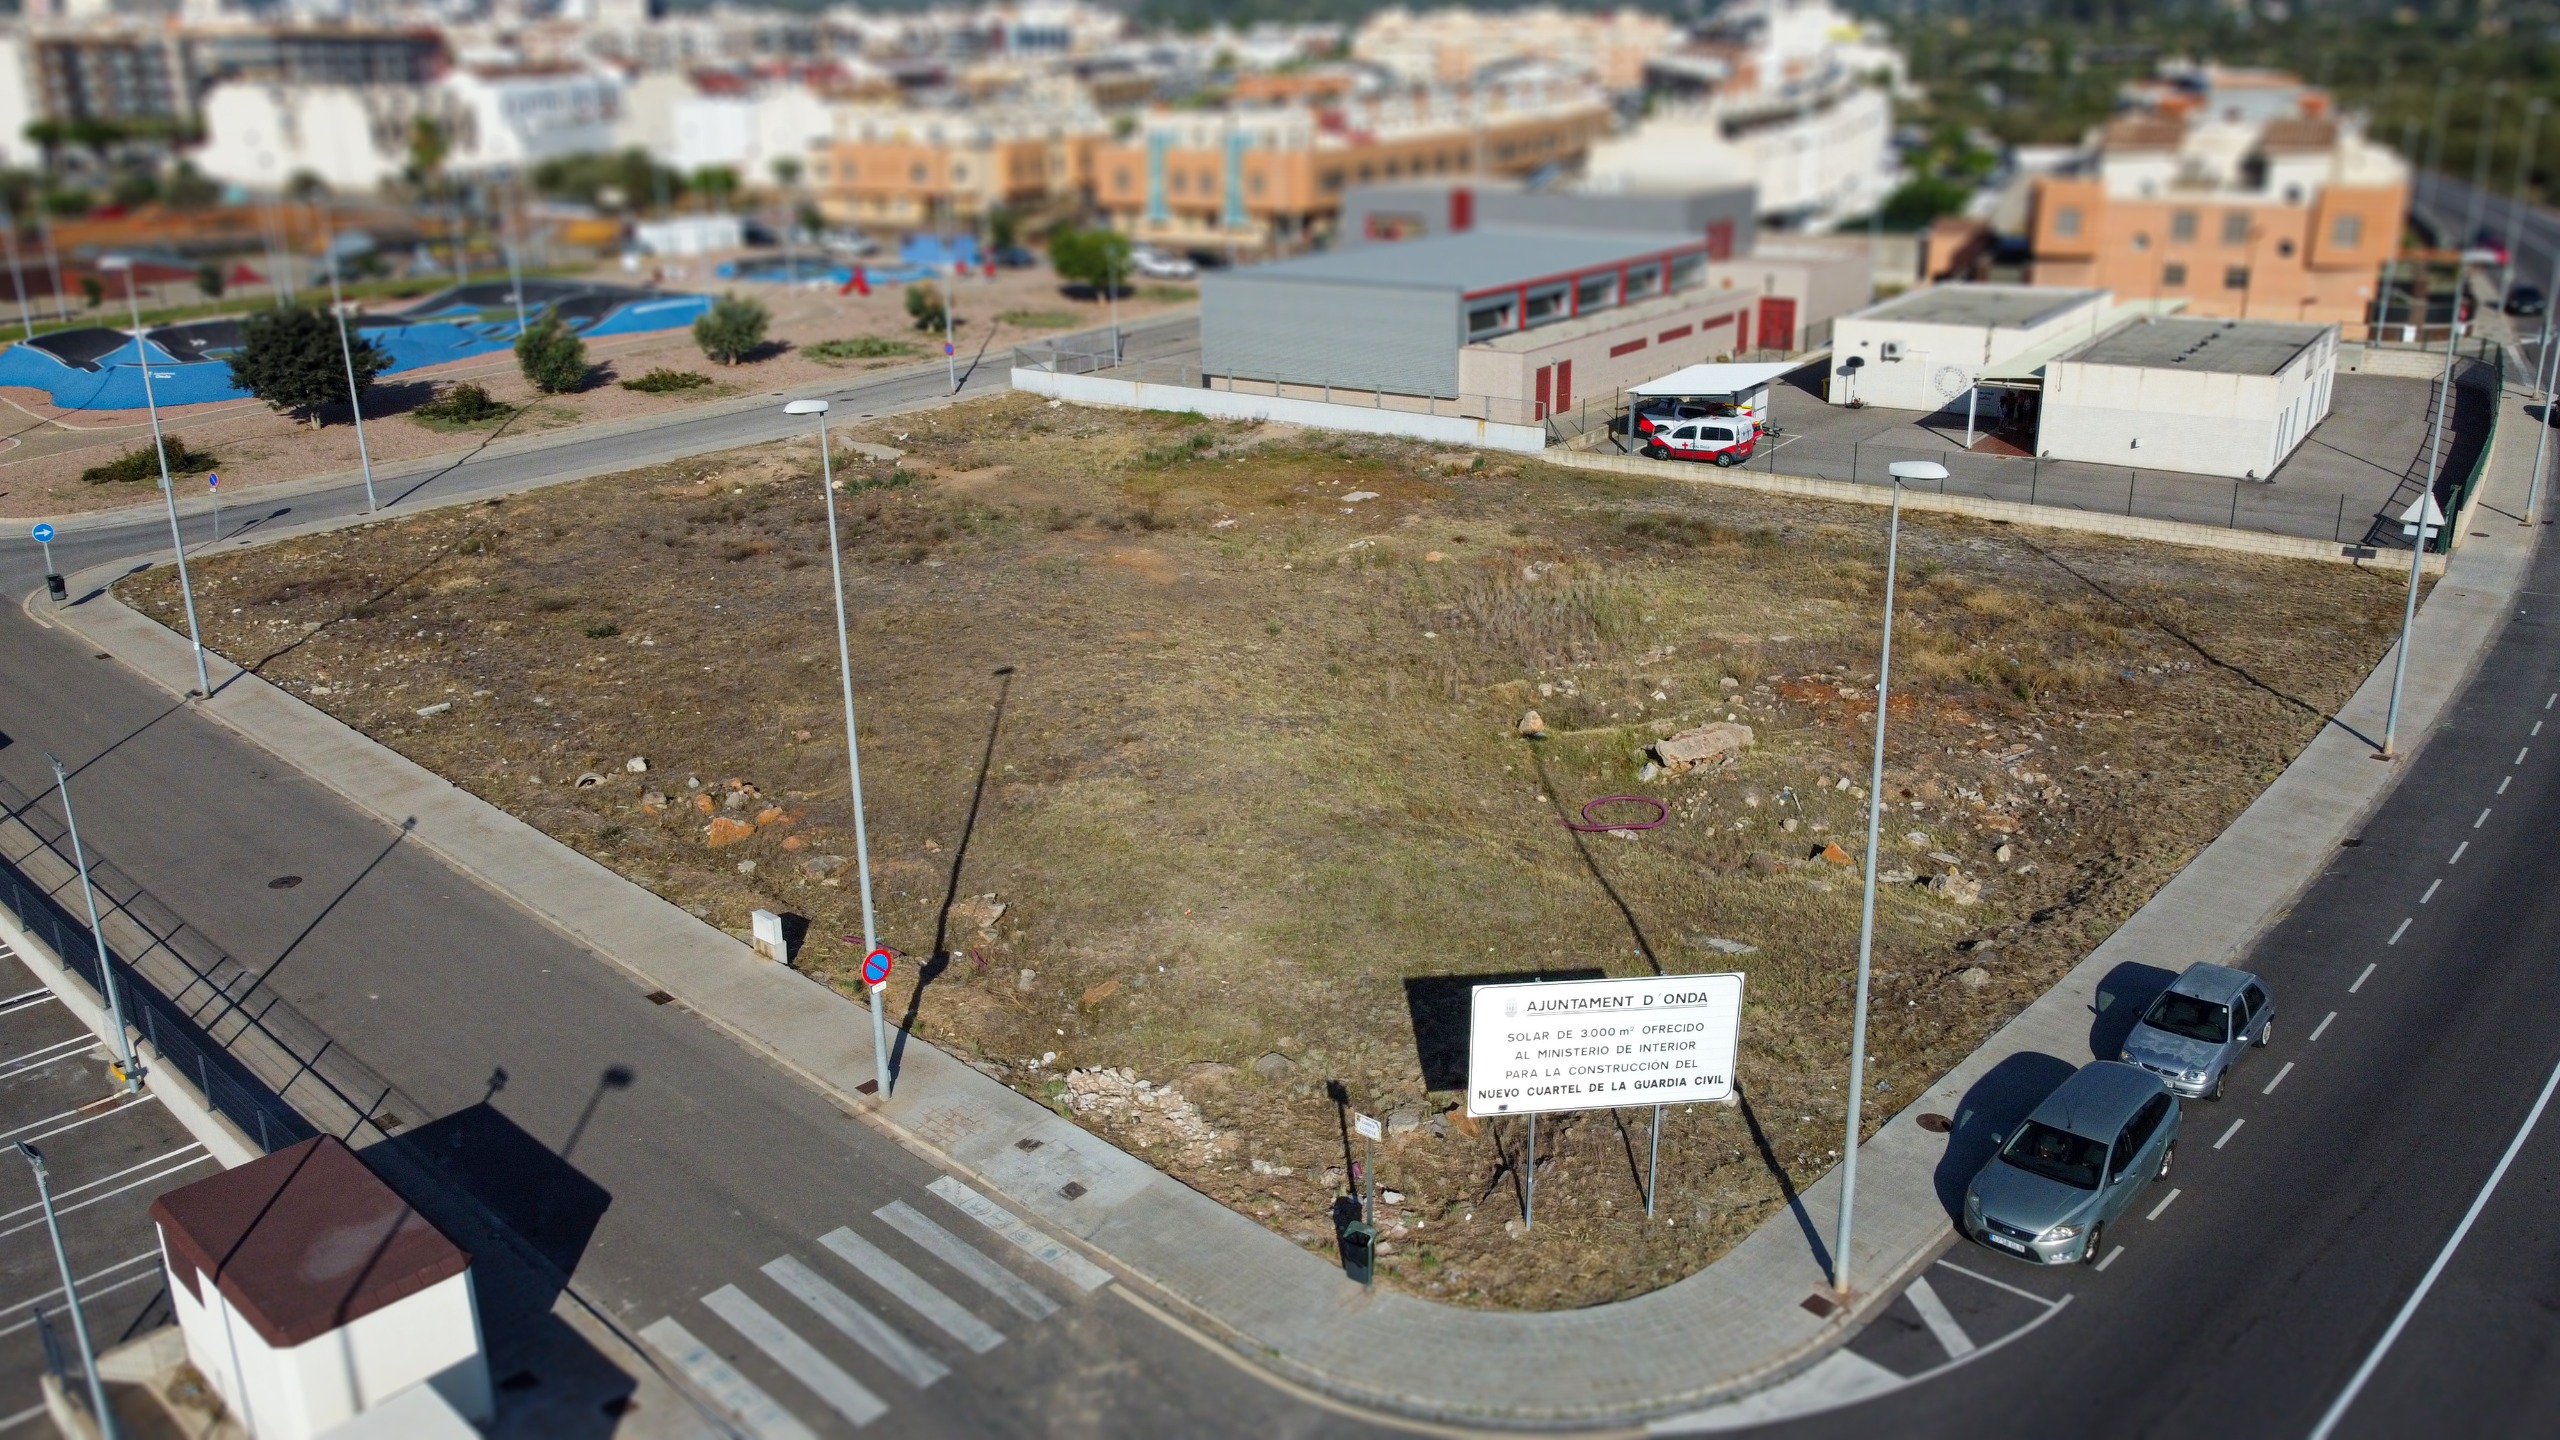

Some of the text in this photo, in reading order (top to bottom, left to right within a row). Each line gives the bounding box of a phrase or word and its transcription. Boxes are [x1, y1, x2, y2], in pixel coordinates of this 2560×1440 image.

[1527, 996, 1634, 1012] AJUNTAMENT
[1508, 1032, 1550, 1042] SOLAR
[1558, 1030, 1573, 1039] DE
[1580, 1028, 1616, 1038] 3.000
[1642, 1022, 1704, 1035] OFRECIDO
[1515, 1041, 1696, 1060] AL MINISTERIO DE INTERIOR
[1505, 1059, 1698, 1079] PARA LA CONSTRUCCIÓN DEL
[1478, 1075, 1724, 1100] NUEVO CUARTEL DE LA GUARDIA CIVIL
